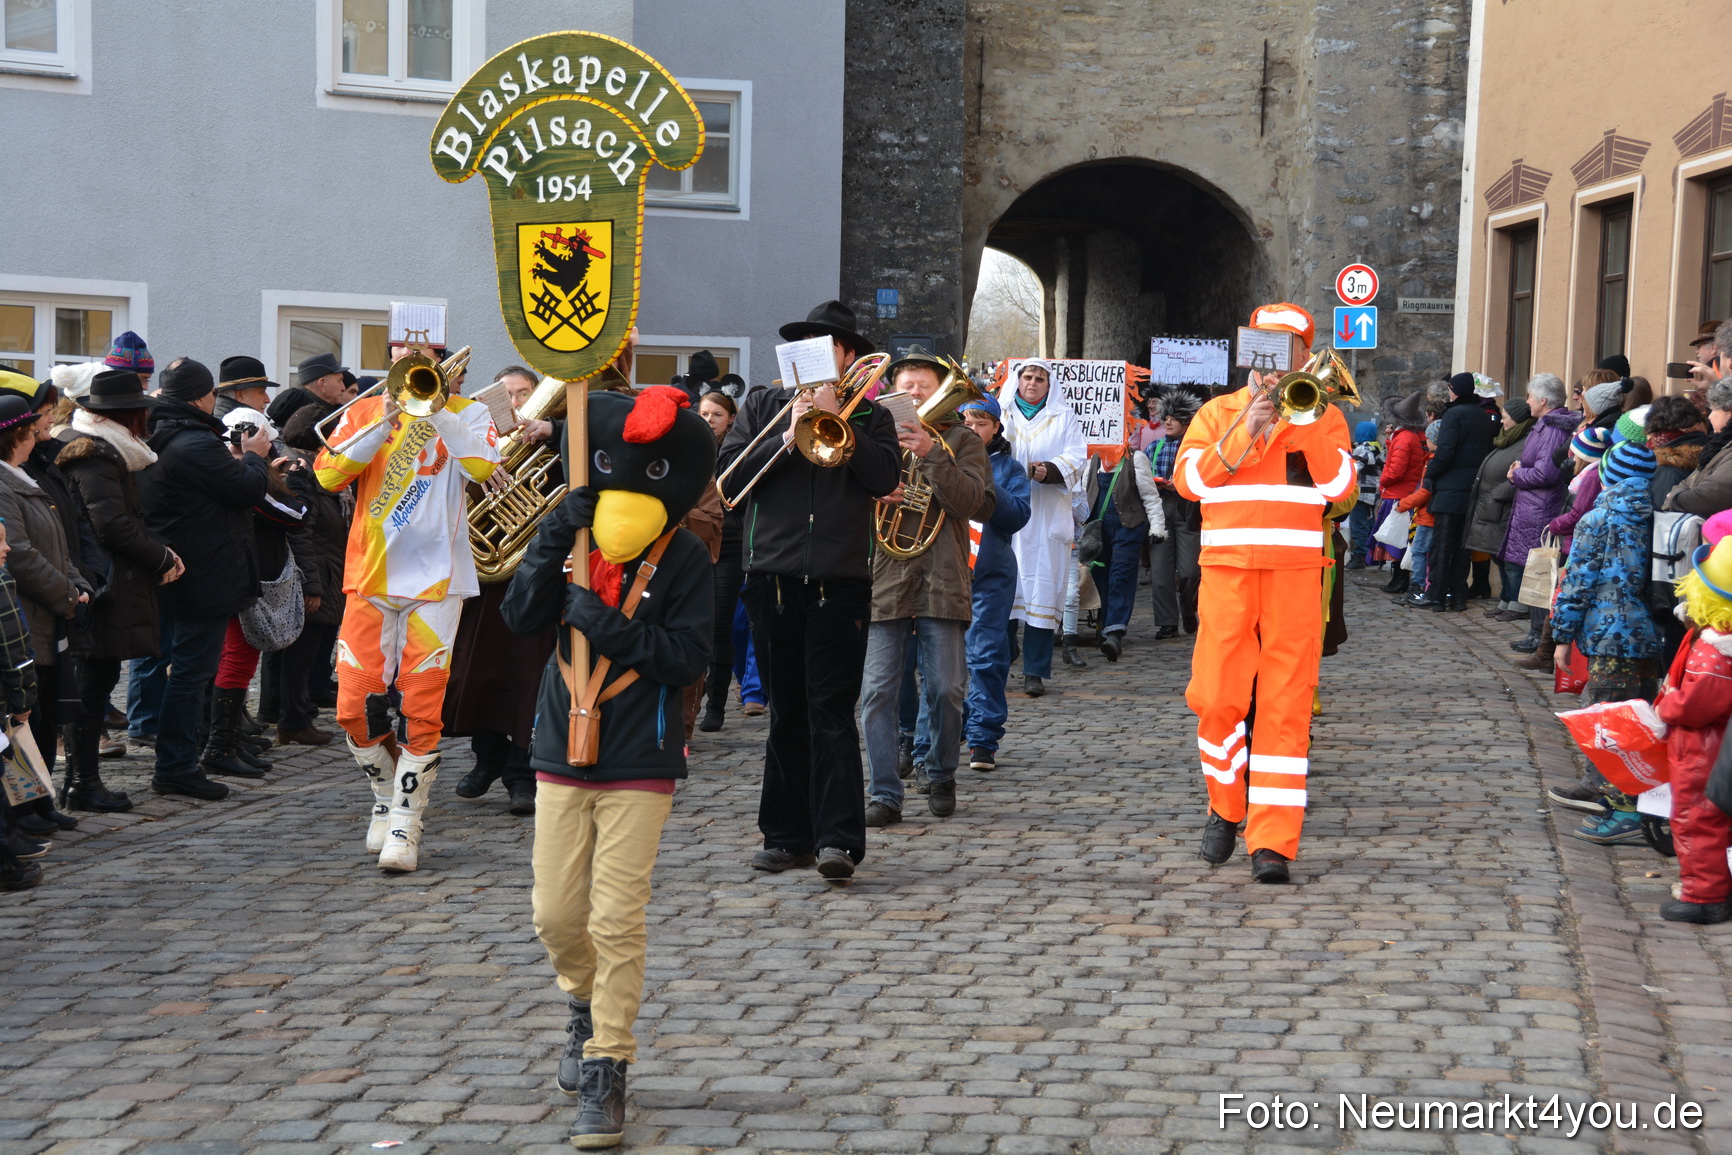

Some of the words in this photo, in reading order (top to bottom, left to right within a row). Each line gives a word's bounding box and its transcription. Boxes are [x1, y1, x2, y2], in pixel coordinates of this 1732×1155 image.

[435, 52, 680, 170] Blaskapelle
[483, 115, 637, 186] Pilsach
[536, 174, 592, 203] 1954
[1347, 276, 1355, 293] 3
[1402, 300, 1455, 311] Ringmauerwe
[1061, 386, 1120, 403] RAUCHEN
[393, 423, 437, 478] Racing
[391, 479, 431, 532] Alpenwelle
[396, 485, 417, 512] RADIO
[1643, 790, 1667, 799] ICHY
